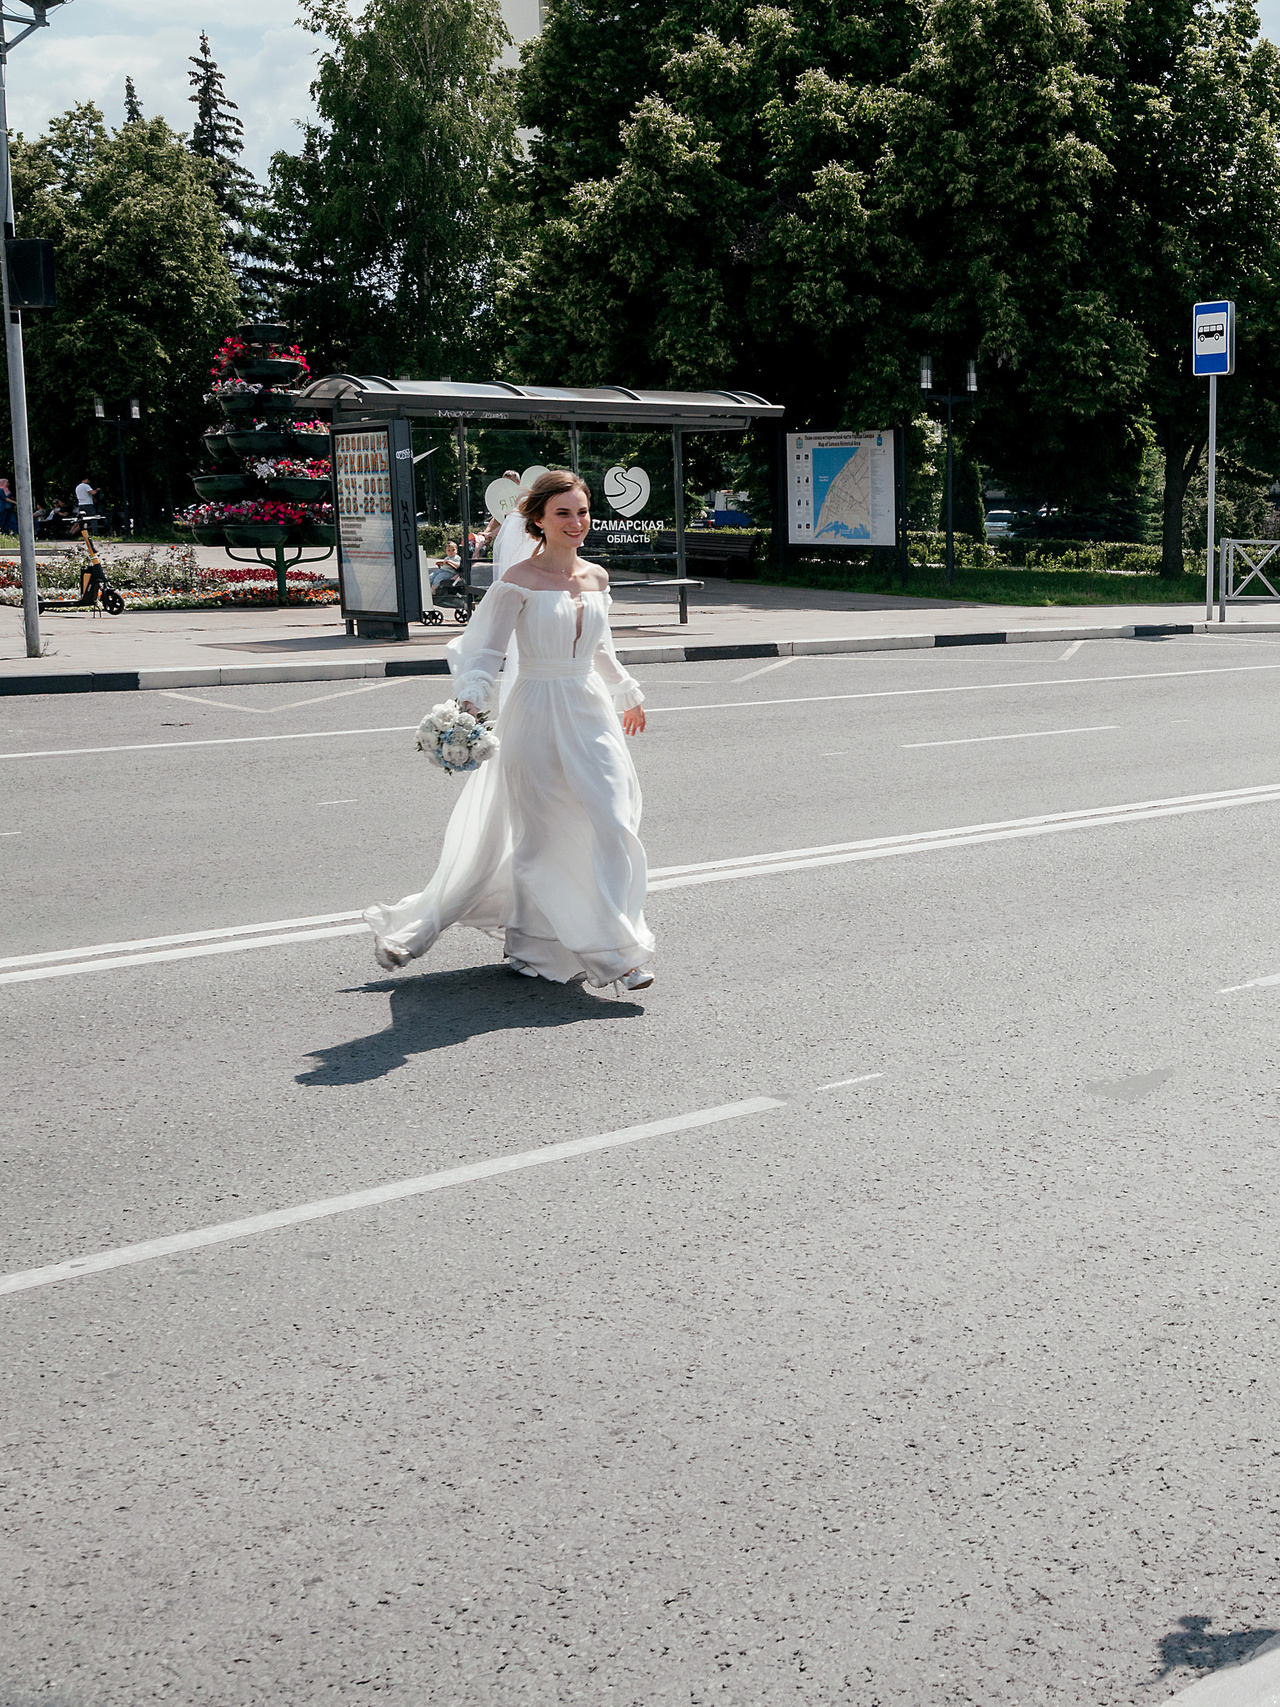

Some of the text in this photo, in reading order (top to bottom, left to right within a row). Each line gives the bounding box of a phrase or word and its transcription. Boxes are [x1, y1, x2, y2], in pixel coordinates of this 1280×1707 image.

[336, 435, 387, 452] РЕВОЛЮЦИЯ
[337, 452, 388, 475] РЕКЛАМЫ
[592, 520, 664, 531] САМАРСКАЯ
[607, 534, 650, 543] ОБЛАСТЬ
